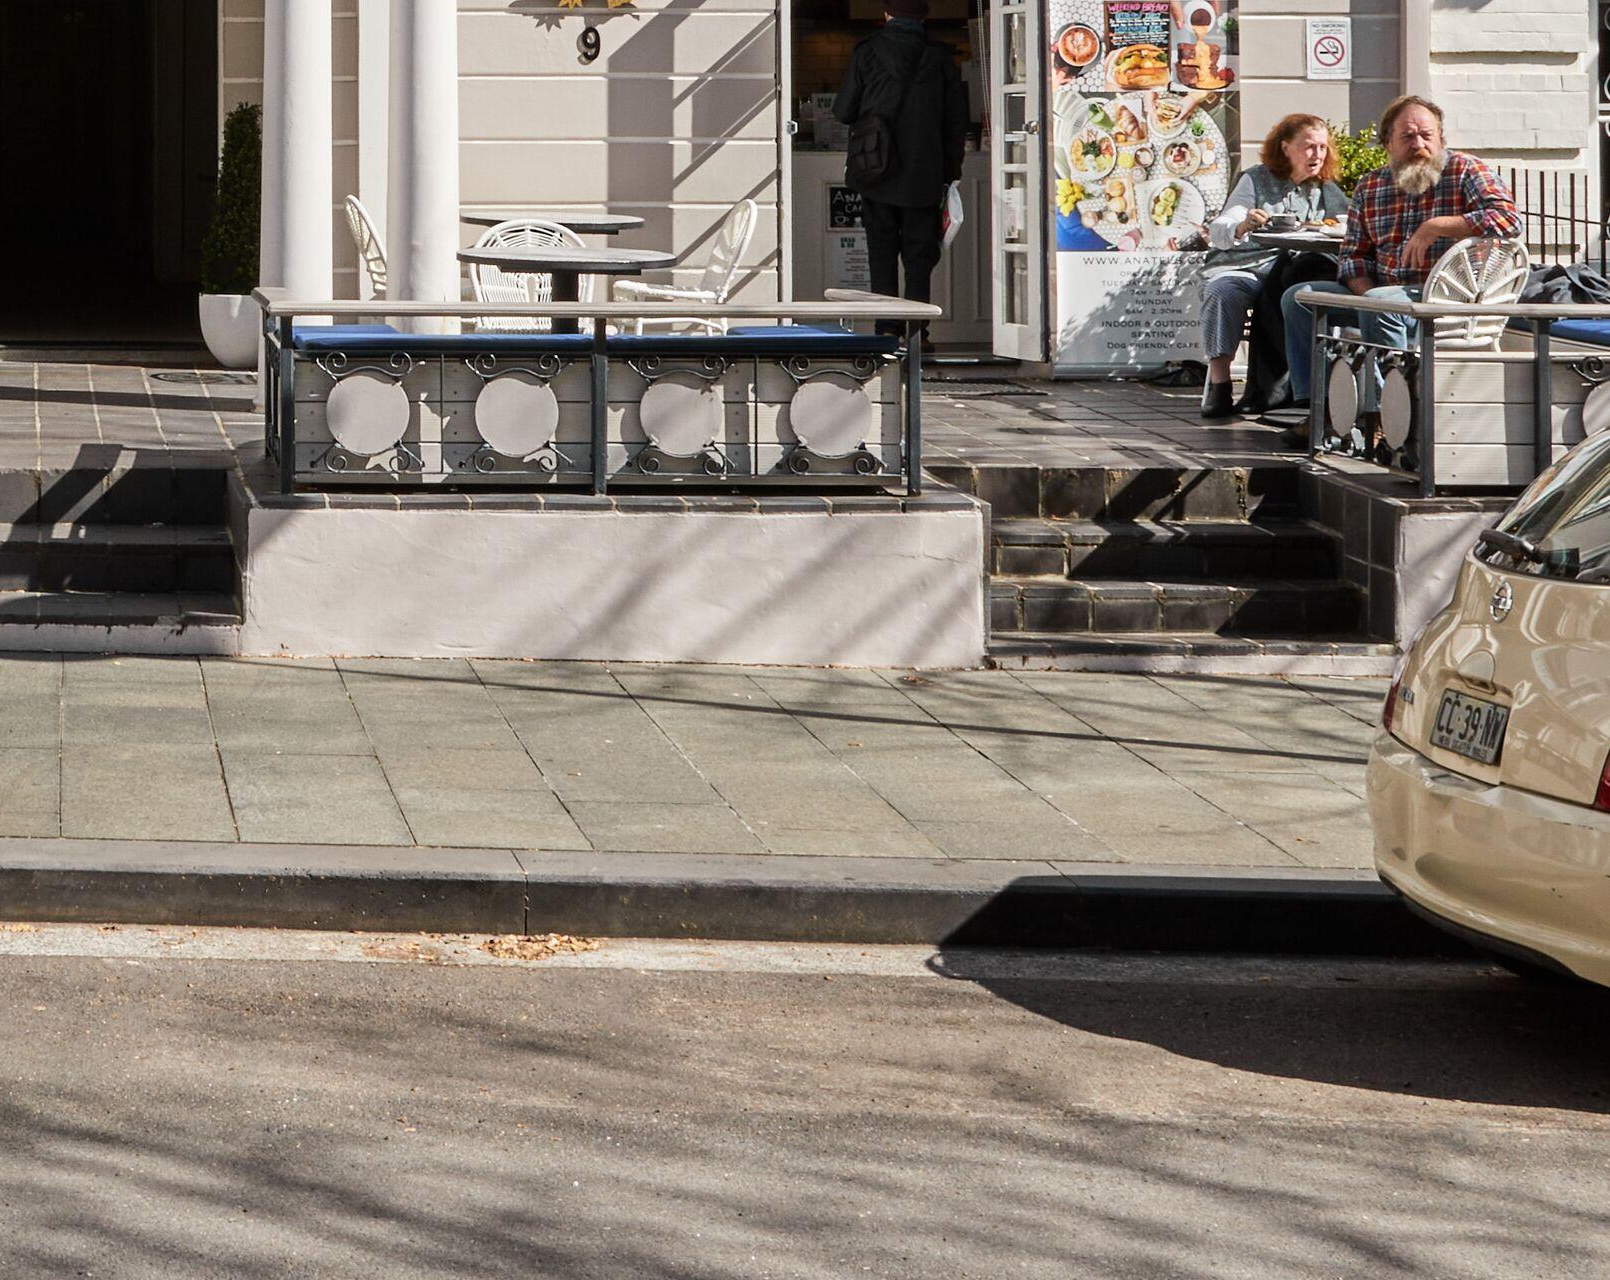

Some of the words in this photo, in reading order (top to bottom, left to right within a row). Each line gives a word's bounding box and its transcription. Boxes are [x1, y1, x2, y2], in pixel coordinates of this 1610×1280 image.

[581, 27, 601, 61] 9
[1101, 320, 1141, 328] INDOOR
[1131, 330, 1175, 338] SEATING
